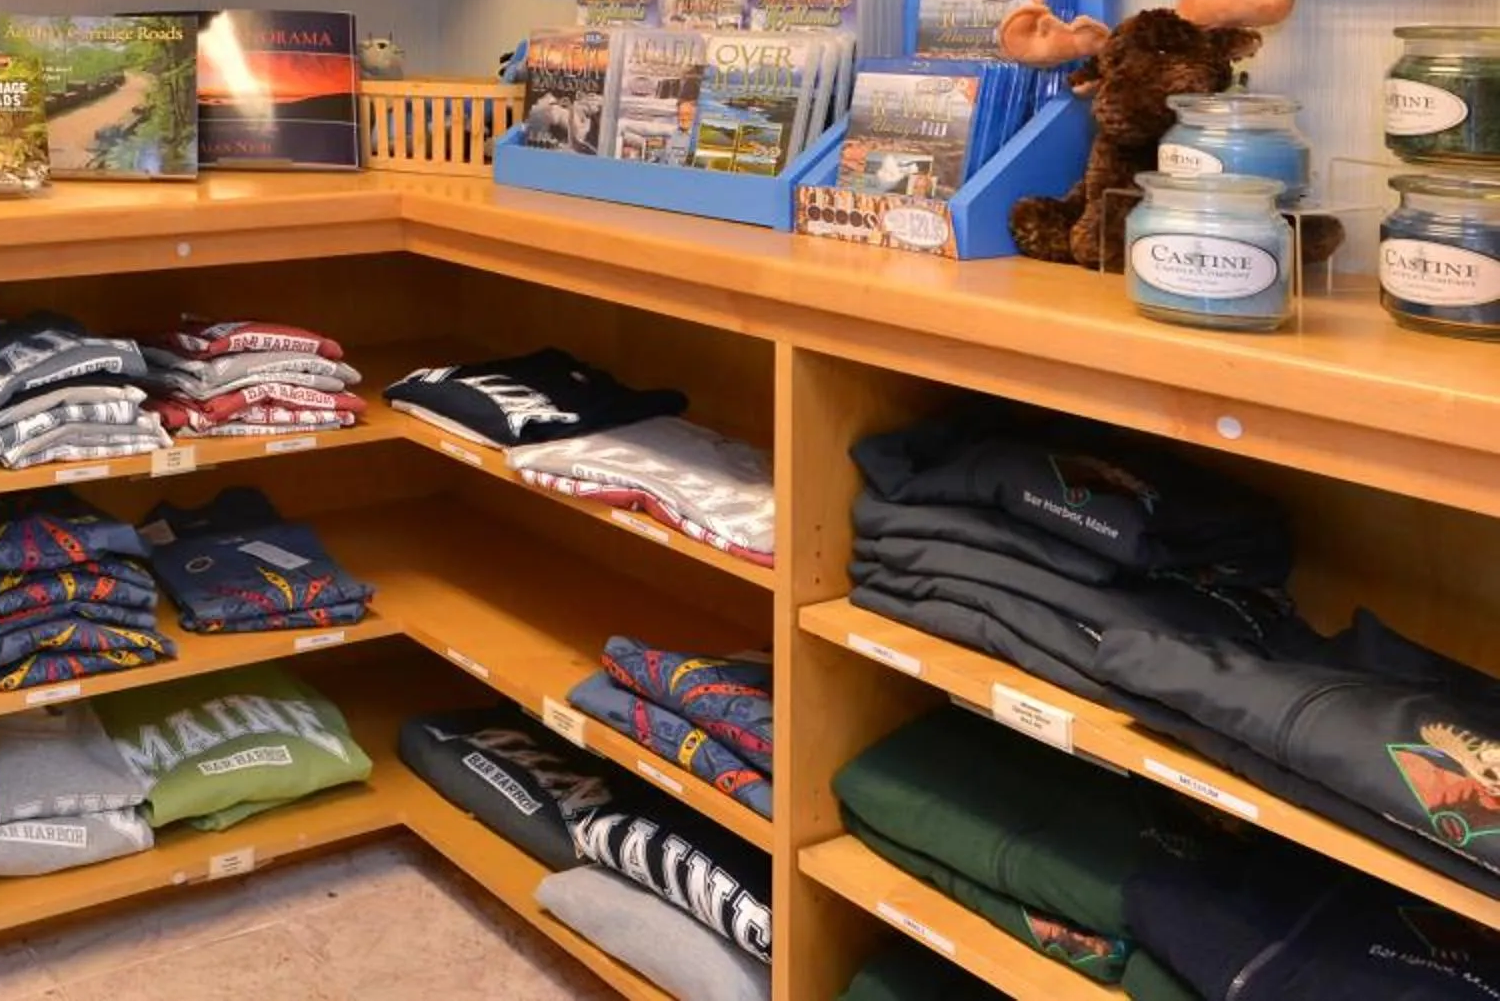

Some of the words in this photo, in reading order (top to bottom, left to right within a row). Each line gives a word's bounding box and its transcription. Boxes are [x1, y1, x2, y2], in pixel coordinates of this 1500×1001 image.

[66, 25, 134, 43] Carriage
[137, 26, 184, 41] Roads
[715, 44, 795, 69] OVER
[1150, 243, 1253, 271] CASTINE
[1384, 248, 1480, 279] CASTINE
[233, 335, 259, 350] BAR
[264, 334, 319, 353] HARBOR
[1023, 490, 1042, 507] Bar
[1043, 499, 1084, 526] Harbor,
[1085, 514, 1120, 540] Maine
[112, 695, 352, 794] MAINE
[201, 758, 234, 776] BAR
[236, 746, 290, 768] HARBOR
[466, 753, 493, 777] BAR
[24, 824, 86, 845] HARBOR
